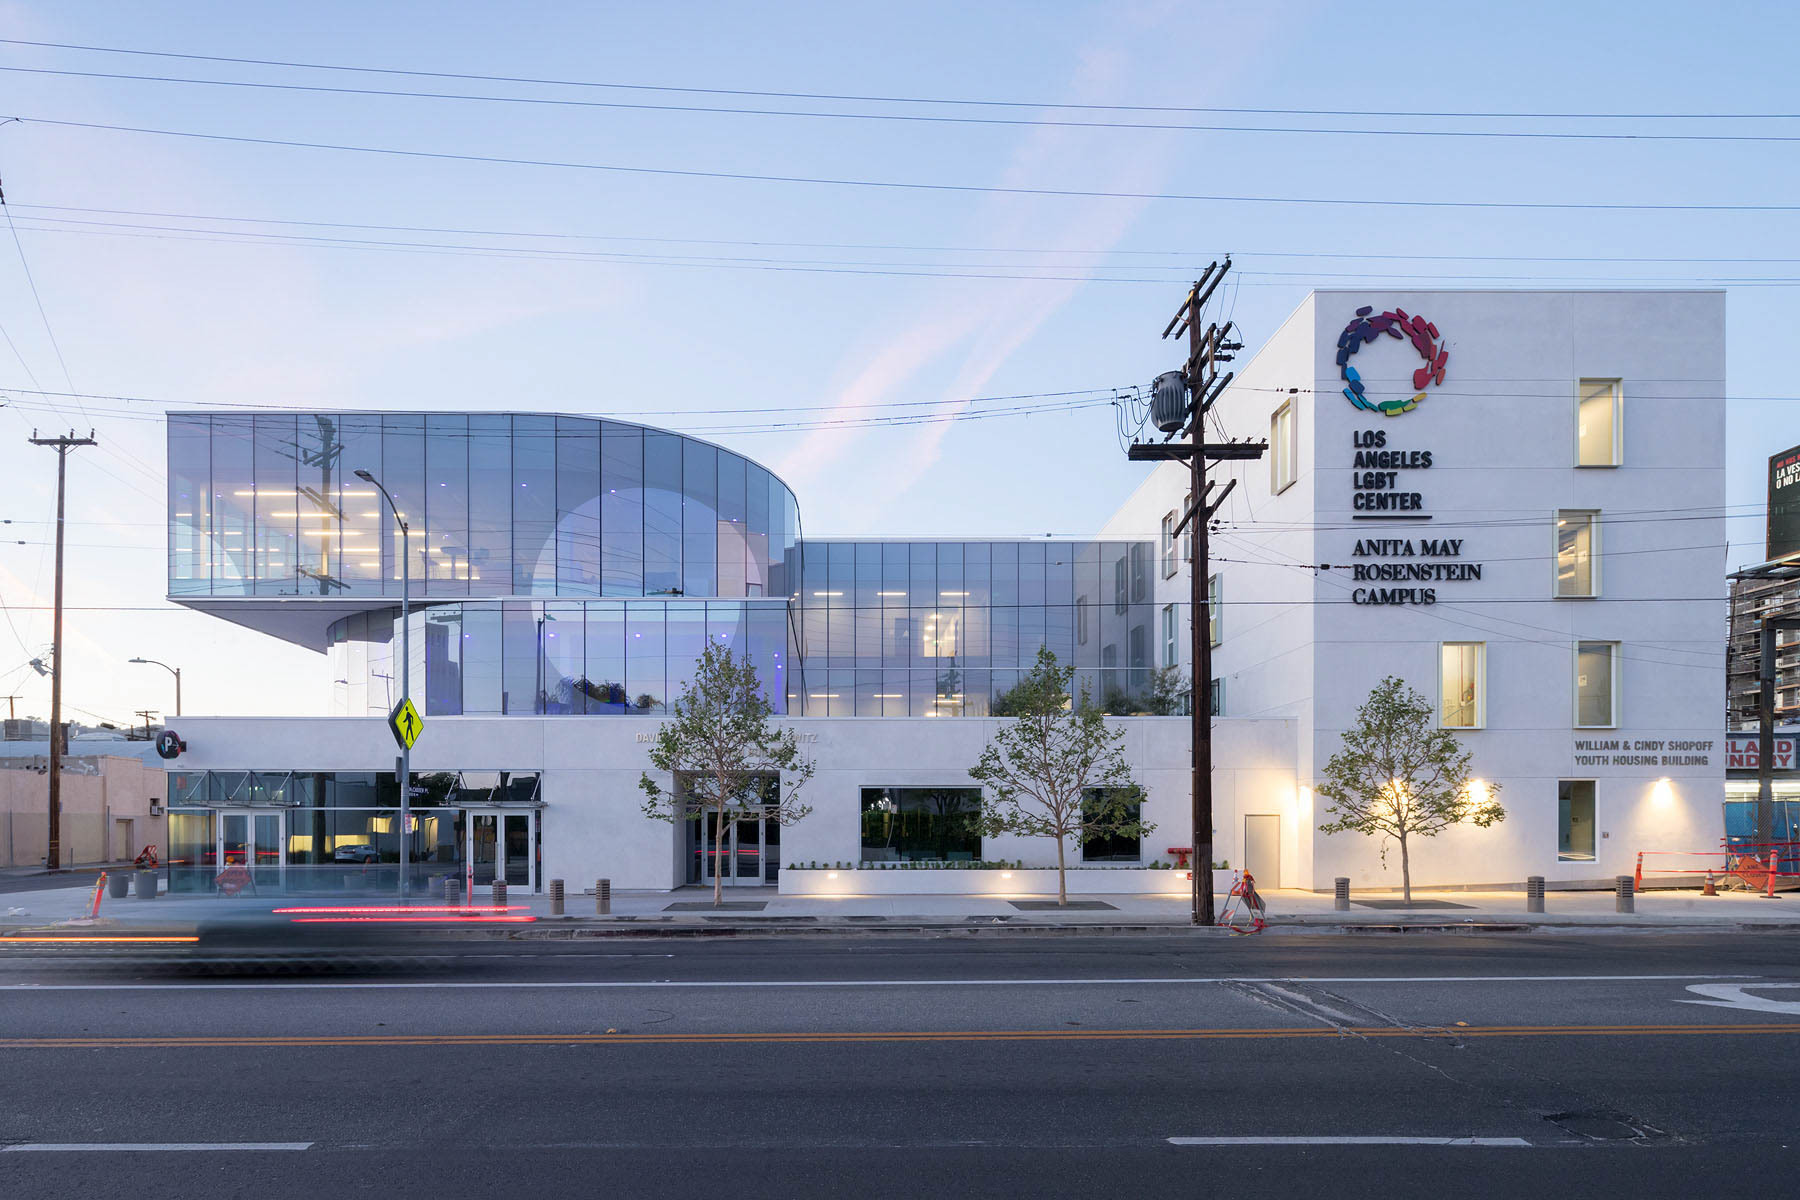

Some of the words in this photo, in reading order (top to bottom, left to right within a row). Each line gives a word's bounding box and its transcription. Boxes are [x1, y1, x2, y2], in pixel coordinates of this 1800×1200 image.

[1354, 430, 1386, 448] LOS
[1353, 451, 1433, 469] ANGELES
[1354, 472, 1397, 490] LGBT
[1777, 468, 1786, 479] LA
[1783, 475, 1794, 486] NO
[1354, 493, 1423, 511] CENTER
[1353, 540, 1416, 556] ANITA
[1420, 540, 1463, 556] MAY
[1353, 564, 1482, 581] ROSENSTEIN
[1353, 588, 1437, 605] CAMPUS
[165, 736, 173, 752] P
[1575, 740, 1619, 751] WILLIAM
[1622, 740, 1631, 751] &
[1634, 740, 1664, 751] CINDY
[1668, 740, 1714, 751] SHOPOFF
[1726, 740, 1792, 753] LAD
[1575, 755, 1609, 766] YOUTH
[1612, 755, 1658, 766] HOUSING
[1662, 755, 1709, 766] BUILDING
